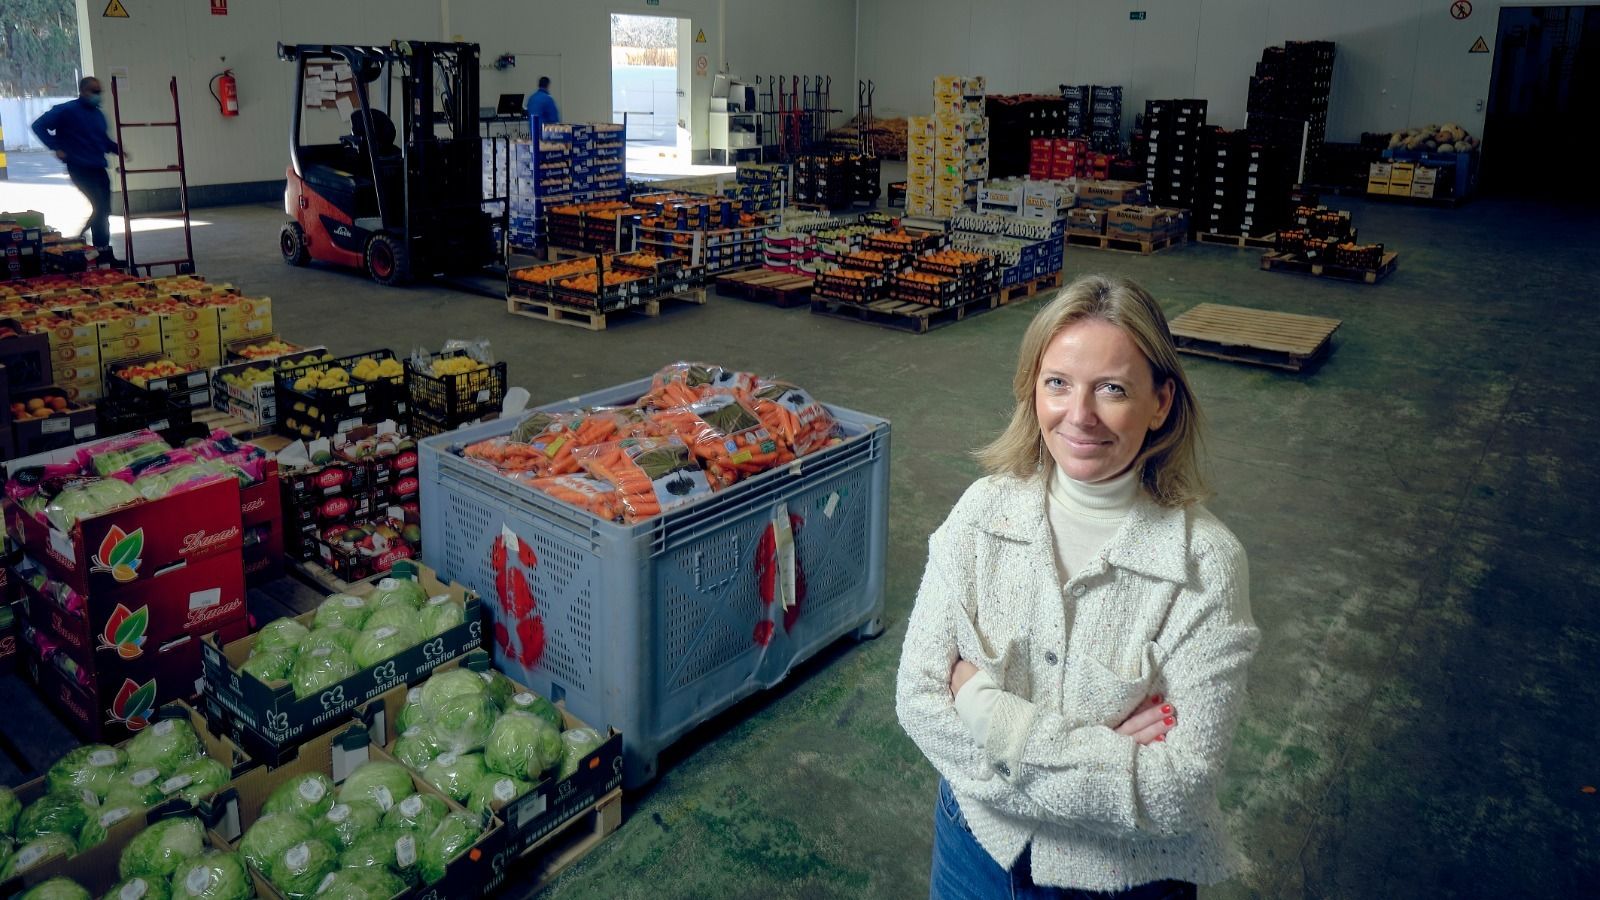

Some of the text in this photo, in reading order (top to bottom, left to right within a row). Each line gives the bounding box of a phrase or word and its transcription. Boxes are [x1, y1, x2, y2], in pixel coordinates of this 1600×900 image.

[416, 648, 456, 675] mimaflor
[365, 670, 409, 699] mimaflor
[312, 696, 359, 726] mimaflor
[261, 723, 304, 742] mimaflor
